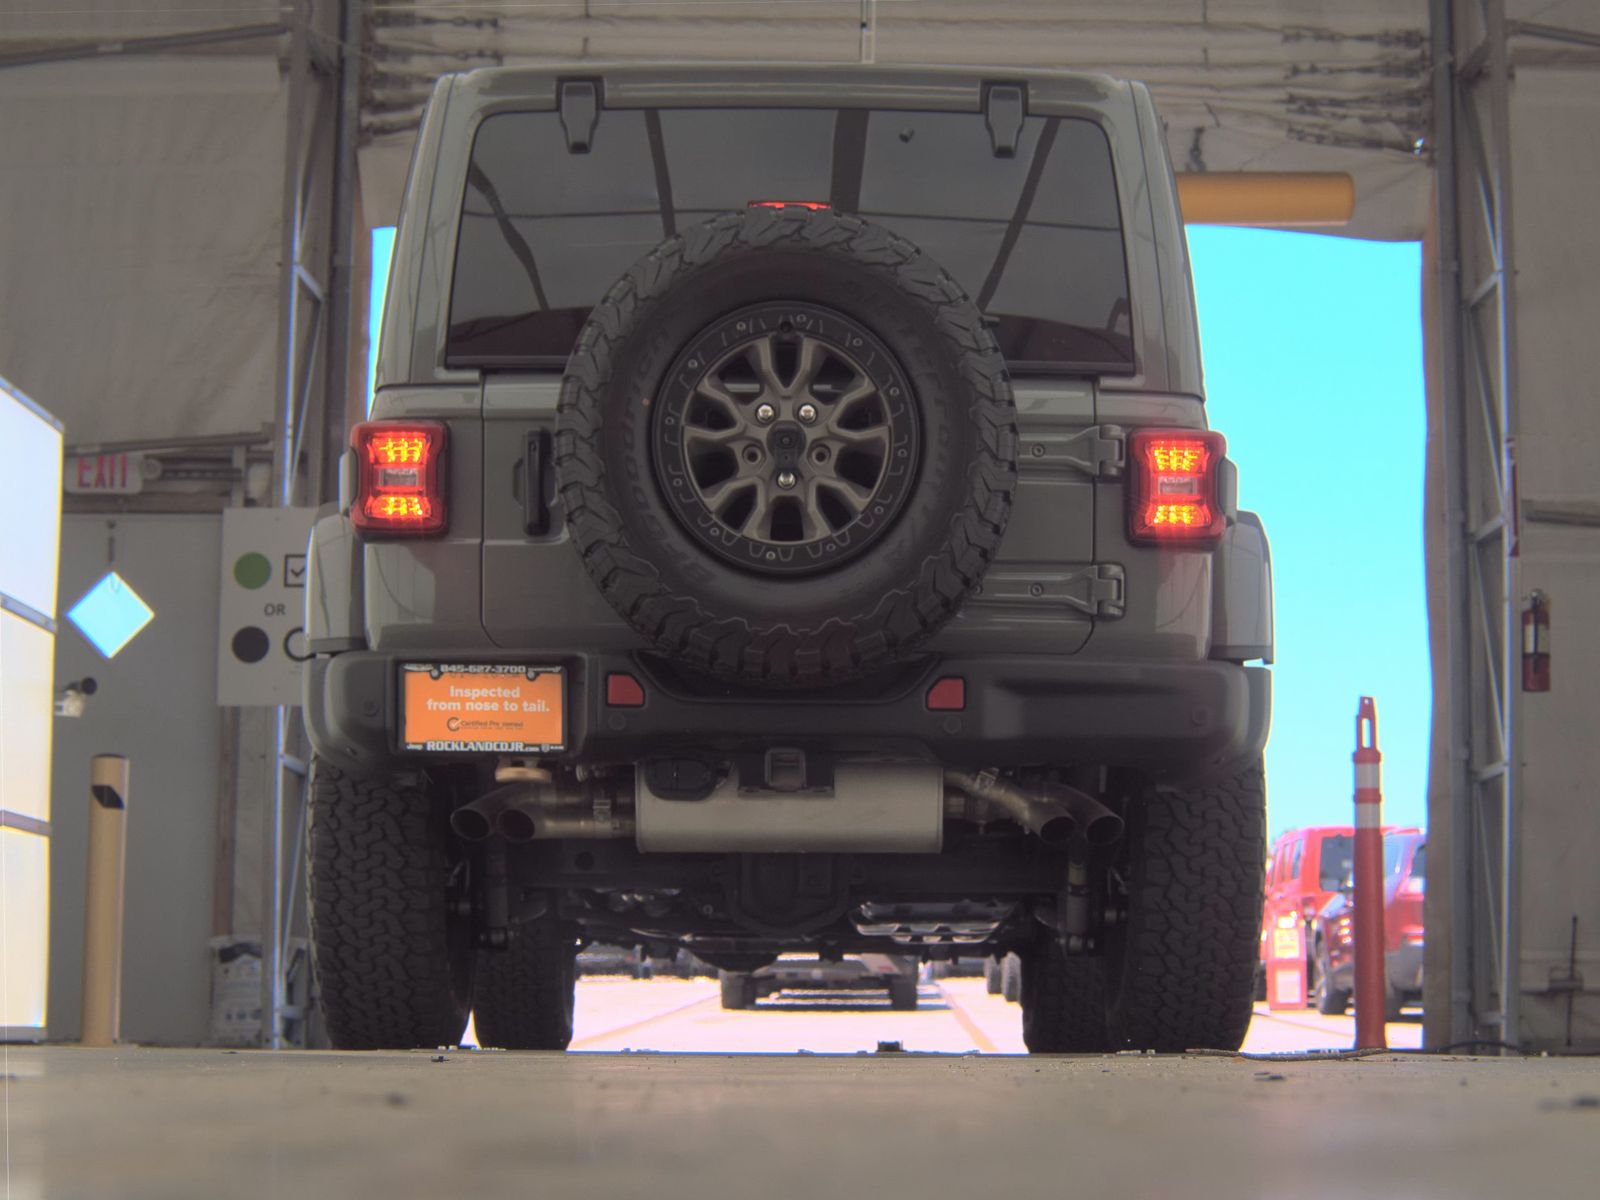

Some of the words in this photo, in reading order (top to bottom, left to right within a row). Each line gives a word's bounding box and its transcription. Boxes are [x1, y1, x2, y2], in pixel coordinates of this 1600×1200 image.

[77, 454, 129, 488] EXIT
[264, 603, 286, 616] OR
[440, 664, 526, 673] 845-627-3700
[449, 686, 521, 700] Inspected
[426, 699, 461, 711] from
[465, 702, 500, 711] nose
[503, 701, 518, 711] to
[522, 700, 550, 712] tail.
